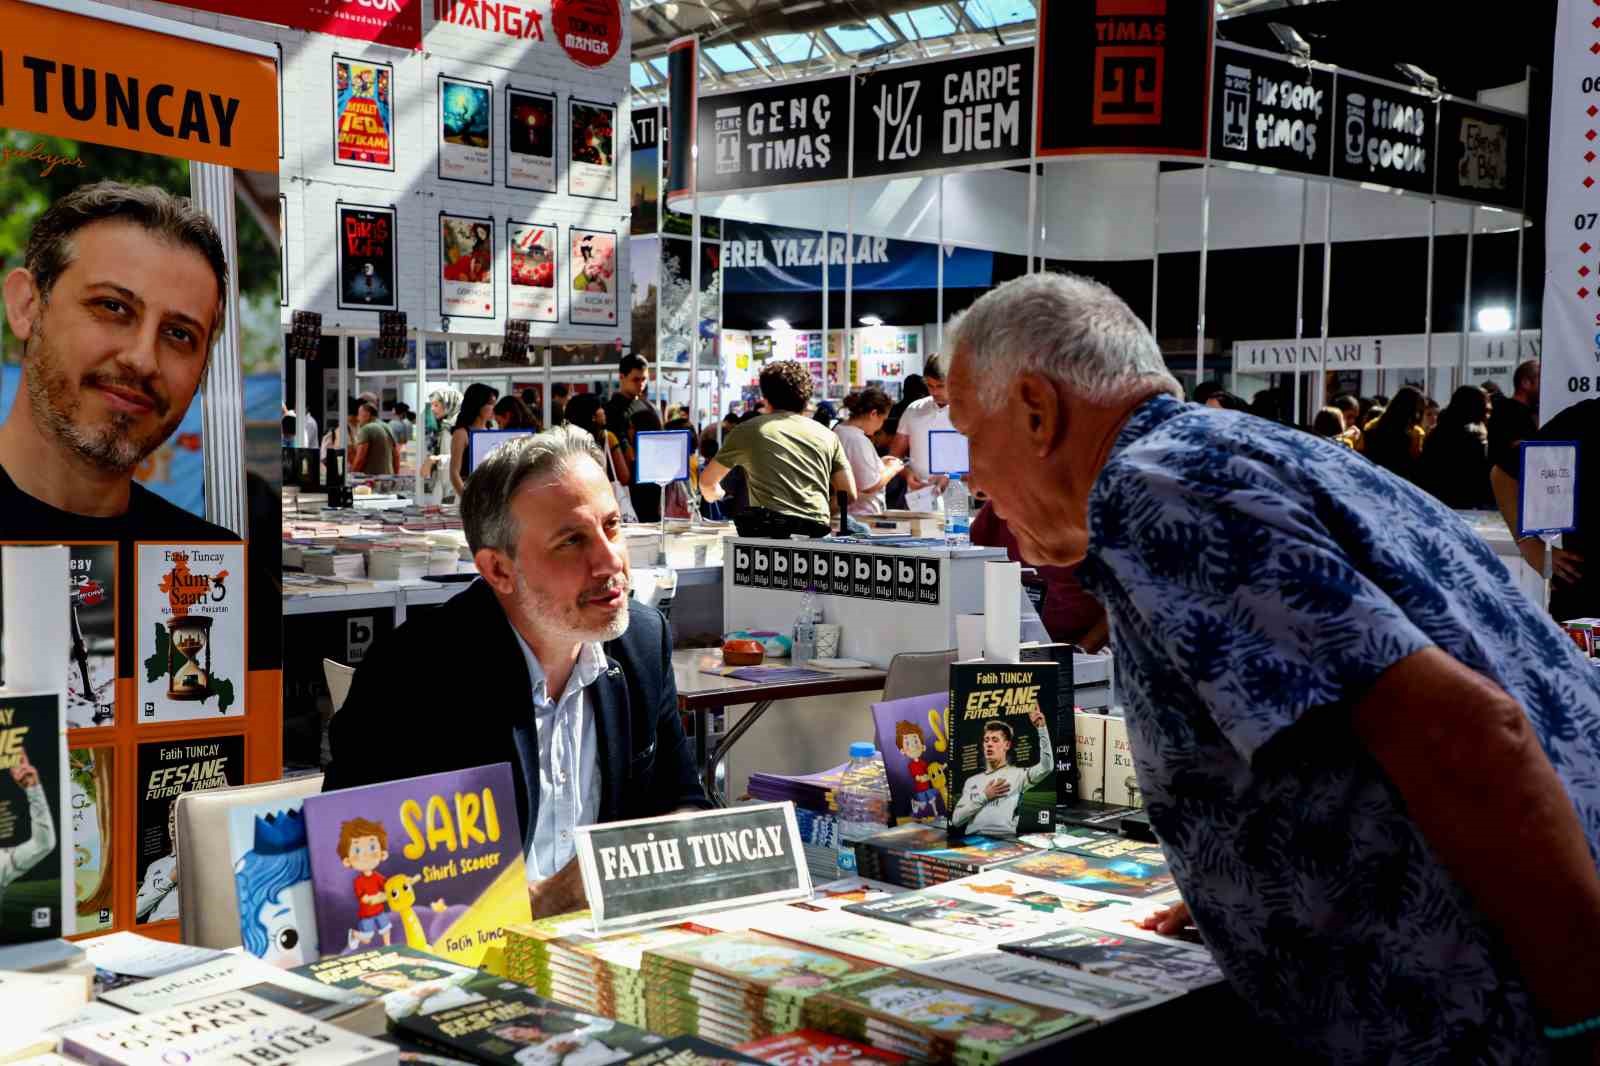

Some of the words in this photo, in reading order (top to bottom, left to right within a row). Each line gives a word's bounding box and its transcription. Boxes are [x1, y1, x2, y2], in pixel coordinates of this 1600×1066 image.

[565, 33, 608, 55] MANGA
[944, 64, 1020, 105] CARPE
[23, 56, 240, 147] TUNCAY
[747, 94, 831, 136] GENÇ
[1575, 213, 1599, 230] 07
[1568, 376, 1590, 393] 08
[192, 550, 225, 565] Tuncay
[736, 549, 749, 569] b
[755, 550, 768, 571] b
[774, 551, 787, 572] b
[793, 553, 808, 574] b
[814, 554, 828, 576] b
[834, 556, 849, 578] b
[855, 558, 870, 580] b
[877, 560, 892, 582] b
[898, 561, 914, 584] b
[921, 563, 936, 585] b
[171, 568, 209, 588] Kum
[211, 576, 226, 602] 3
[736, 573, 749, 584] Bilgi
[754, 574, 769, 585] Bilgi
[774, 575, 788, 587] Bilgi
[793, 577, 808, 588] Bilgi
[834, 581, 849, 593] Bilgi
[855, 584, 870, 595] Bilgi
[876, 585, 892, 597] Bilgi
[898, 587, 914, 598] Bilgi
[920, 589, 937, 600] Bilgi
[171, 587, 208, 605] Saati
[976, 672, 998, 684] Fatih
[1000, 672, 1033, 684] TUNCAY
[966, 685, 1041, 710] EFSANE
[964, 708, 1000, 720] FUTBOL
[160, 749, 183, 760] Fatih
[185, 744, 219, 759] TUNCAY
[148, 757, 228, 790] EFSANE
[145, 783, 184, 801] FUTBOL
[400, 787, 500, 860] SARI
[599, 833, 684, 881] FATİH
[688, 825, 785, 867] TUNCAY
[446, 934, 473, 953] Fatih
